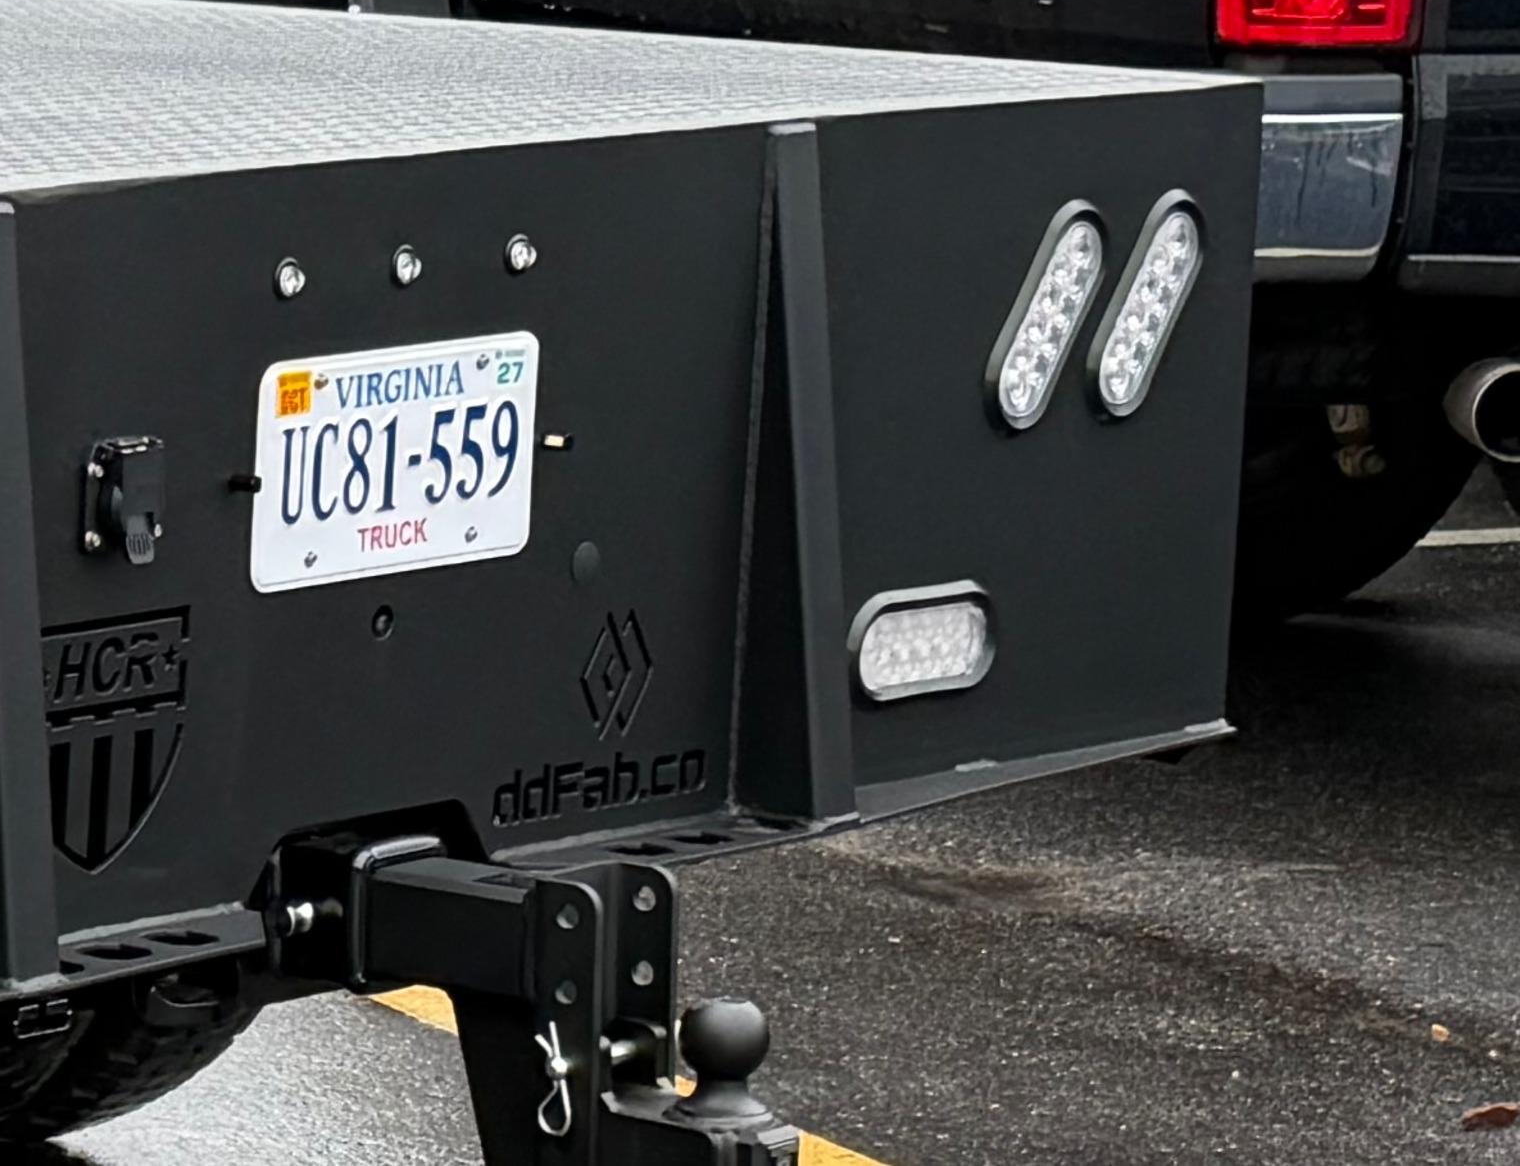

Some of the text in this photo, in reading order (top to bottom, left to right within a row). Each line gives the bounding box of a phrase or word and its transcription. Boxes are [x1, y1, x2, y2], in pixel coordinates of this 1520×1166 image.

[335, 360, 465, 409] VIRGINIA
[497, 362, 523, 384] 27
[281, 399, 520, 525] UC81-559
[357, 518, 428, 552] TRUCK
[53, 632, 159, 704] HCR
[492, 748, 706, 827] ddFab.co
